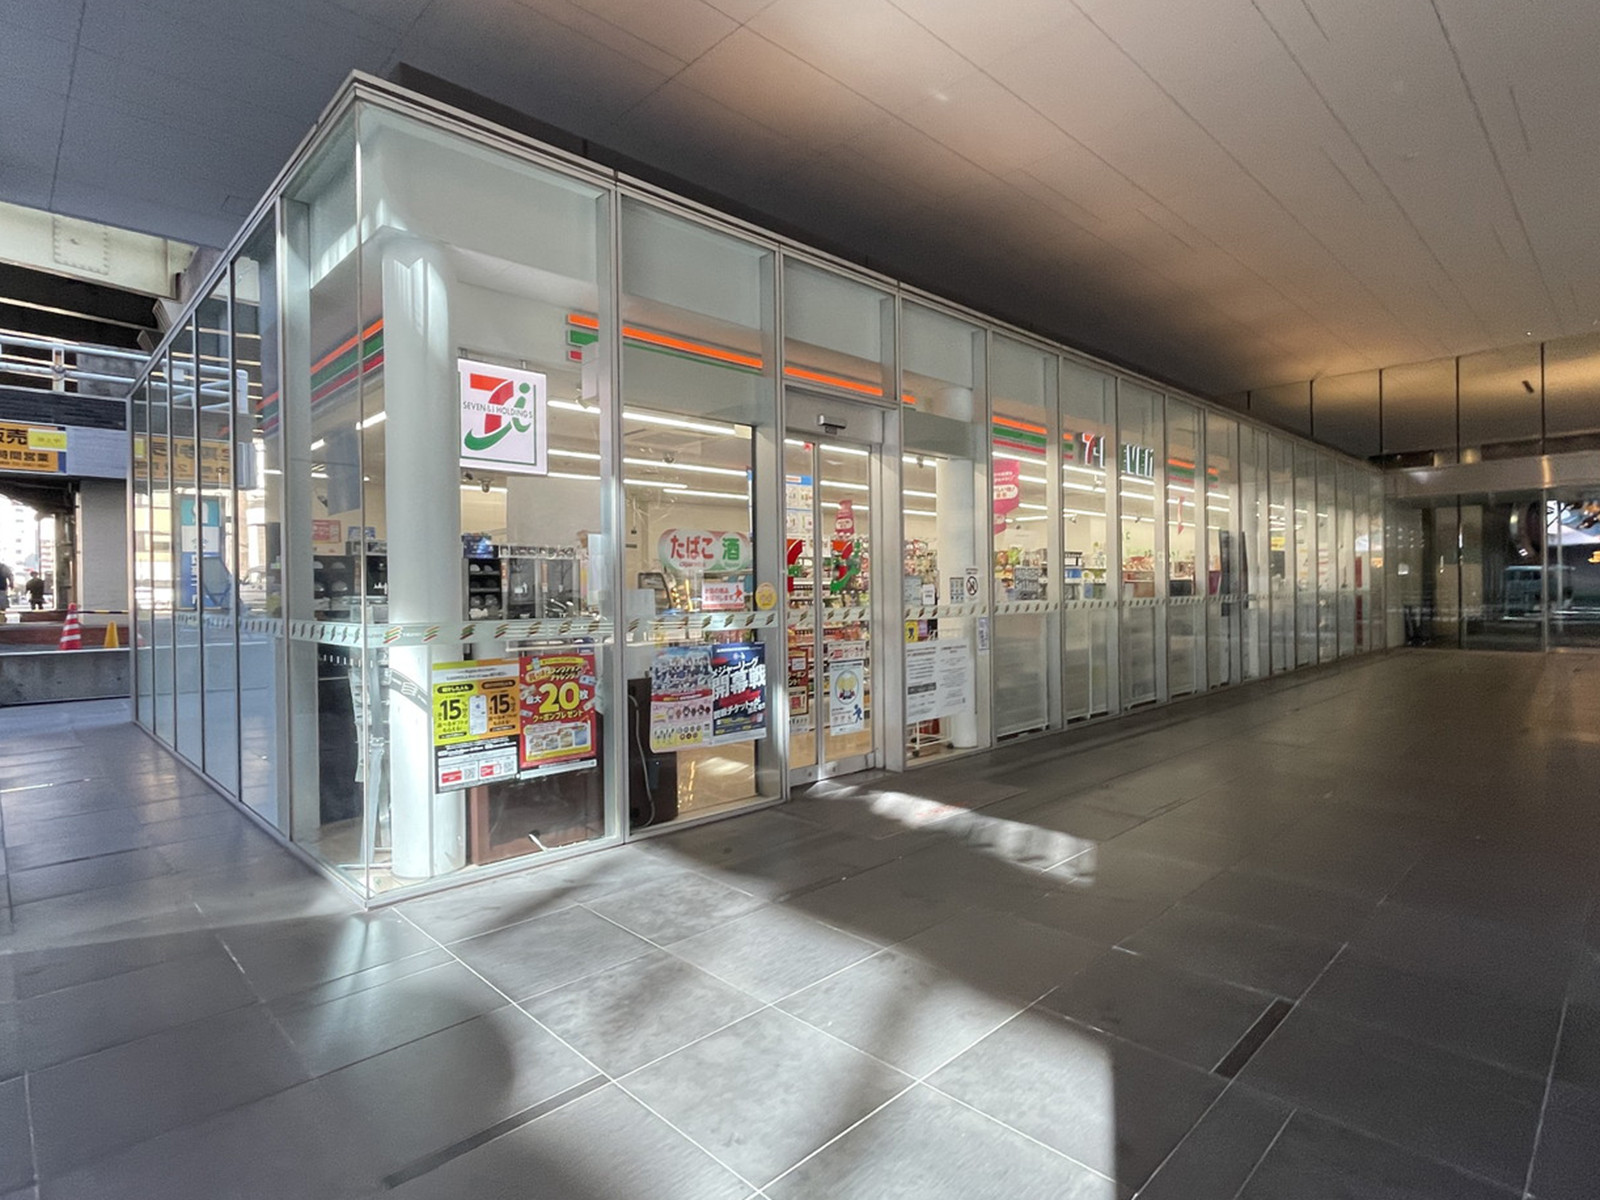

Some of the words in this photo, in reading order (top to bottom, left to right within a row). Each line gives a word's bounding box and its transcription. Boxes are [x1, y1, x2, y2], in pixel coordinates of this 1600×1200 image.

[463, 401, 486, 412] SEVEN
[496, 406, 533, 419] HOLDINGS
[0, 427, 28, 445] 売
[671, 535, 714, 559] たばこ
[722, 538, 740, 560] 酒
[440, 699, 462, 721] 15
[490, 694, 510, 715] 15
